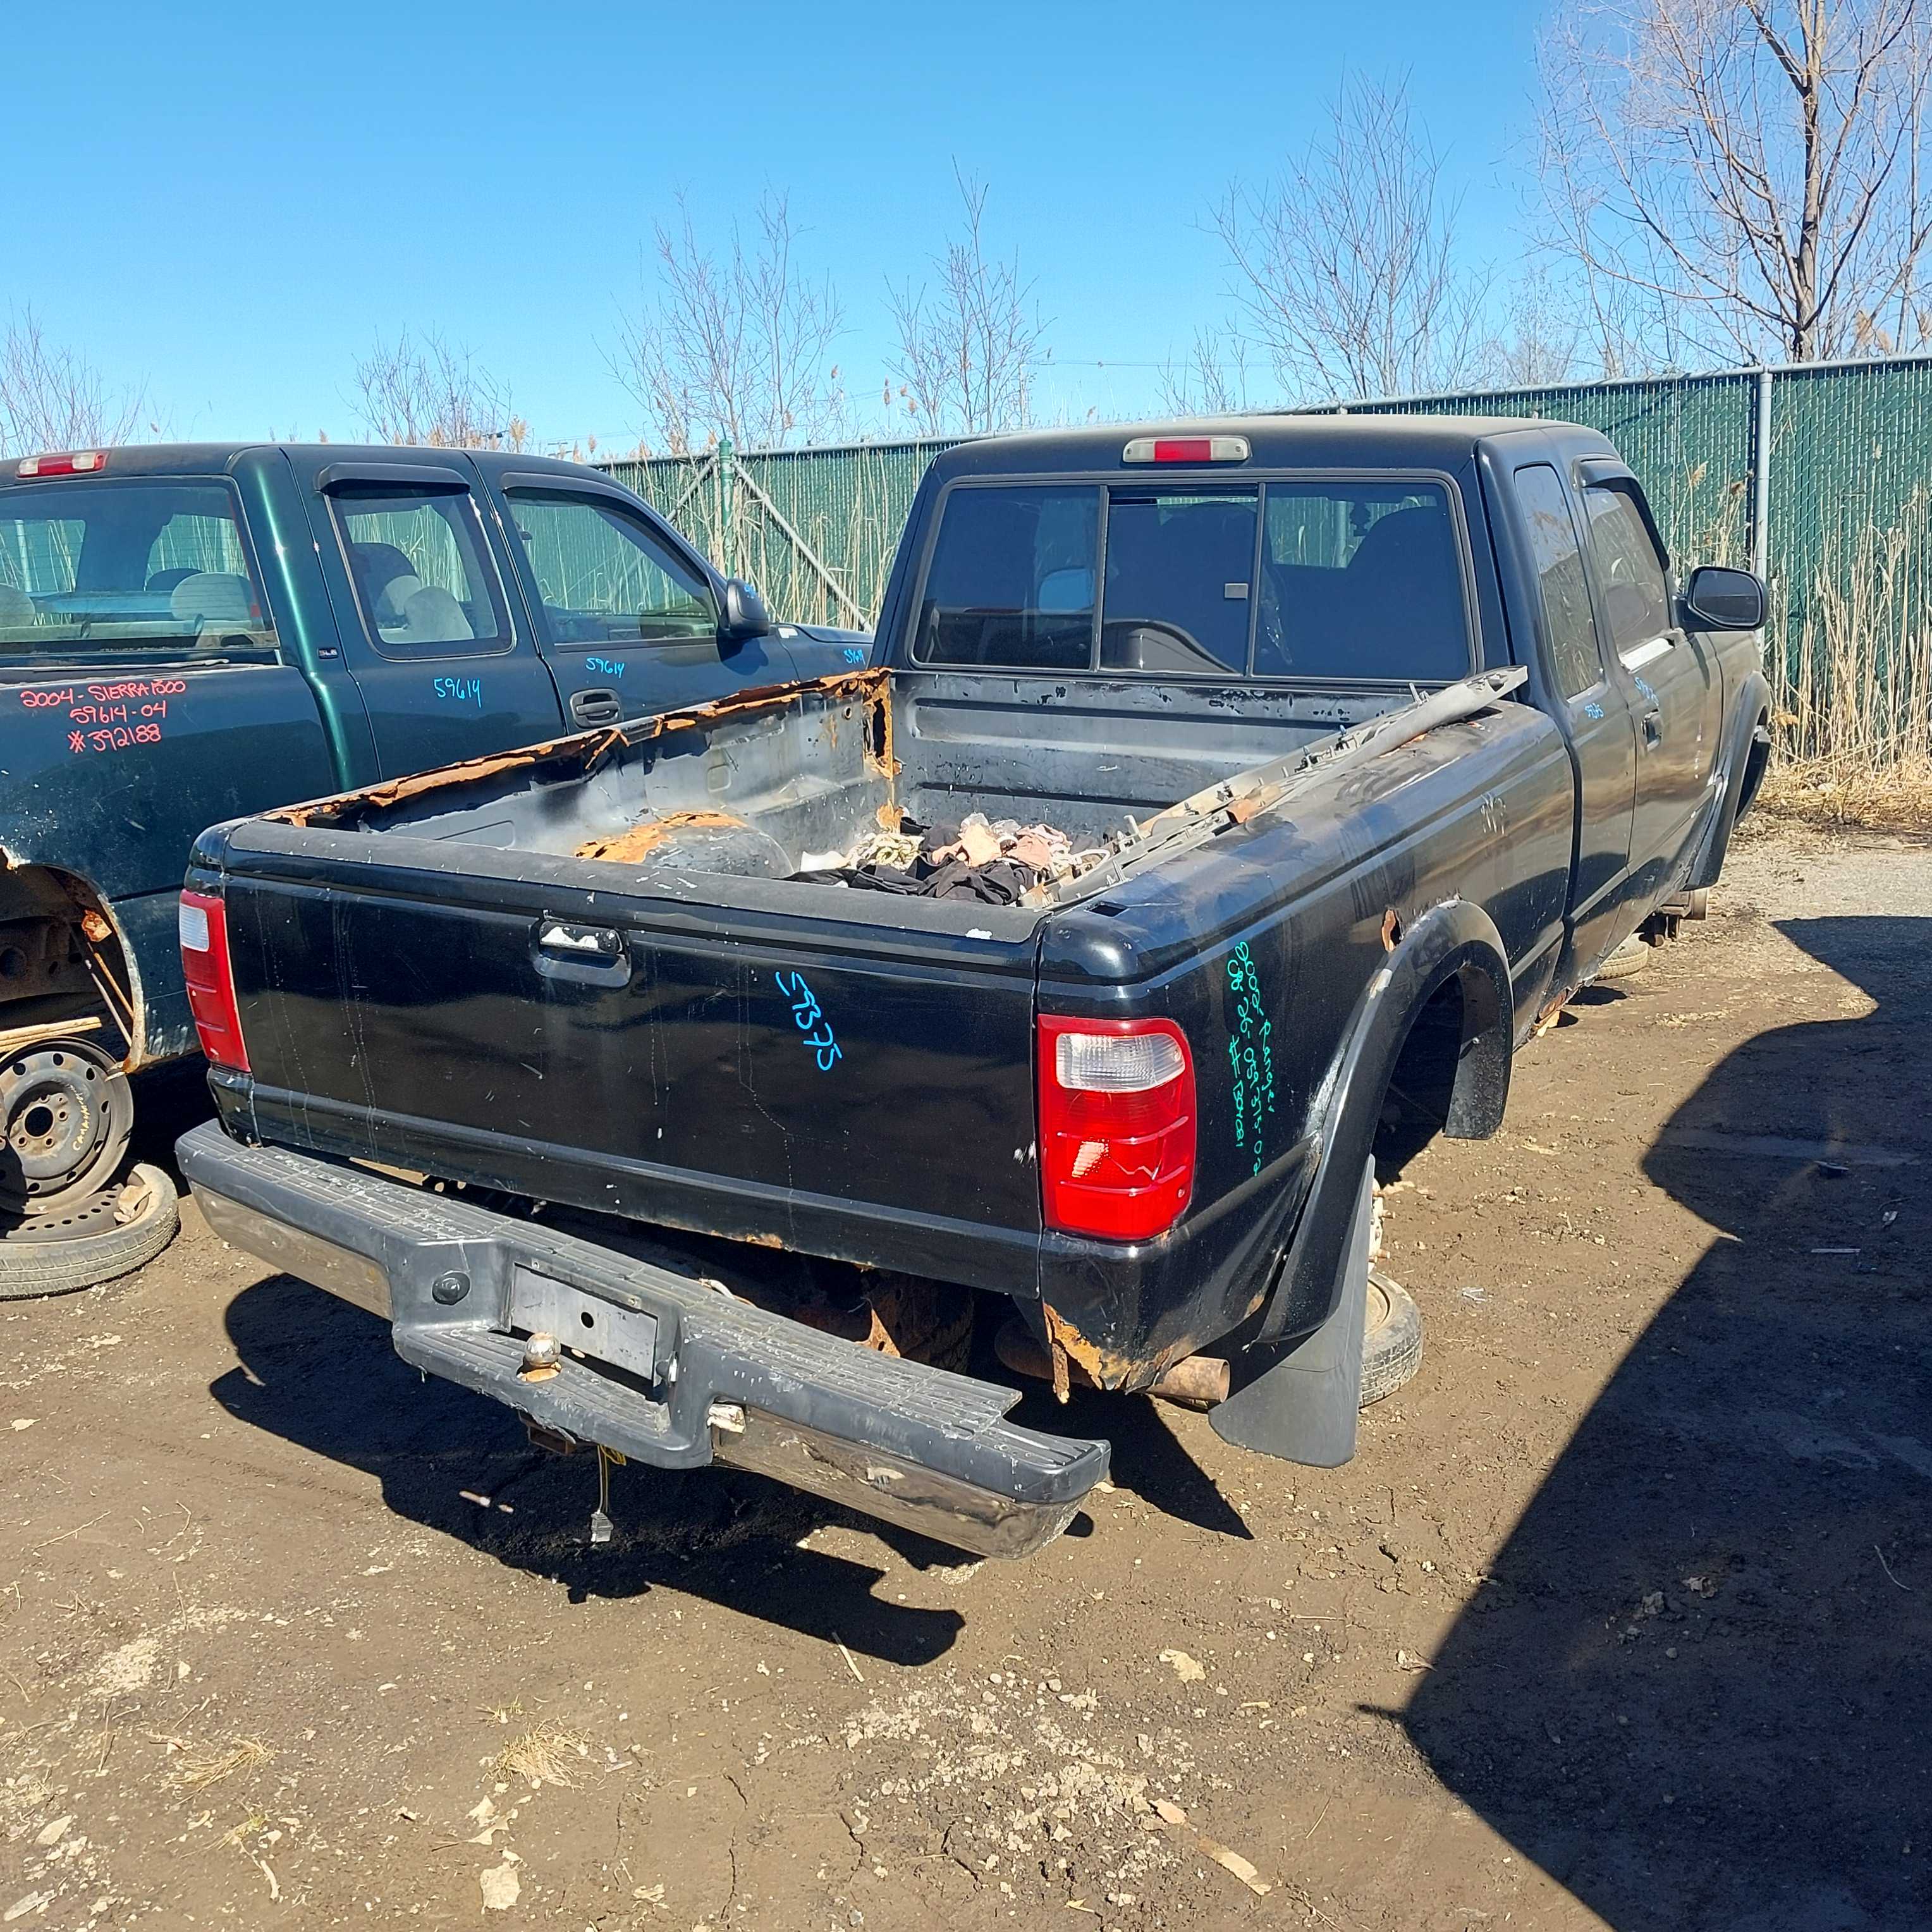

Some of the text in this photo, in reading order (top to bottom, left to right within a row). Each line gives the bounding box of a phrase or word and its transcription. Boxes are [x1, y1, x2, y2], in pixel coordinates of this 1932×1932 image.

[585, 657, 625, 679] 59614
[87, 682, 149, 702] SIERRA
[150, 679, 186, 695] 1500
[434, 677, 482, 709] 59614
[775, 970, 843, 1071] 59375
